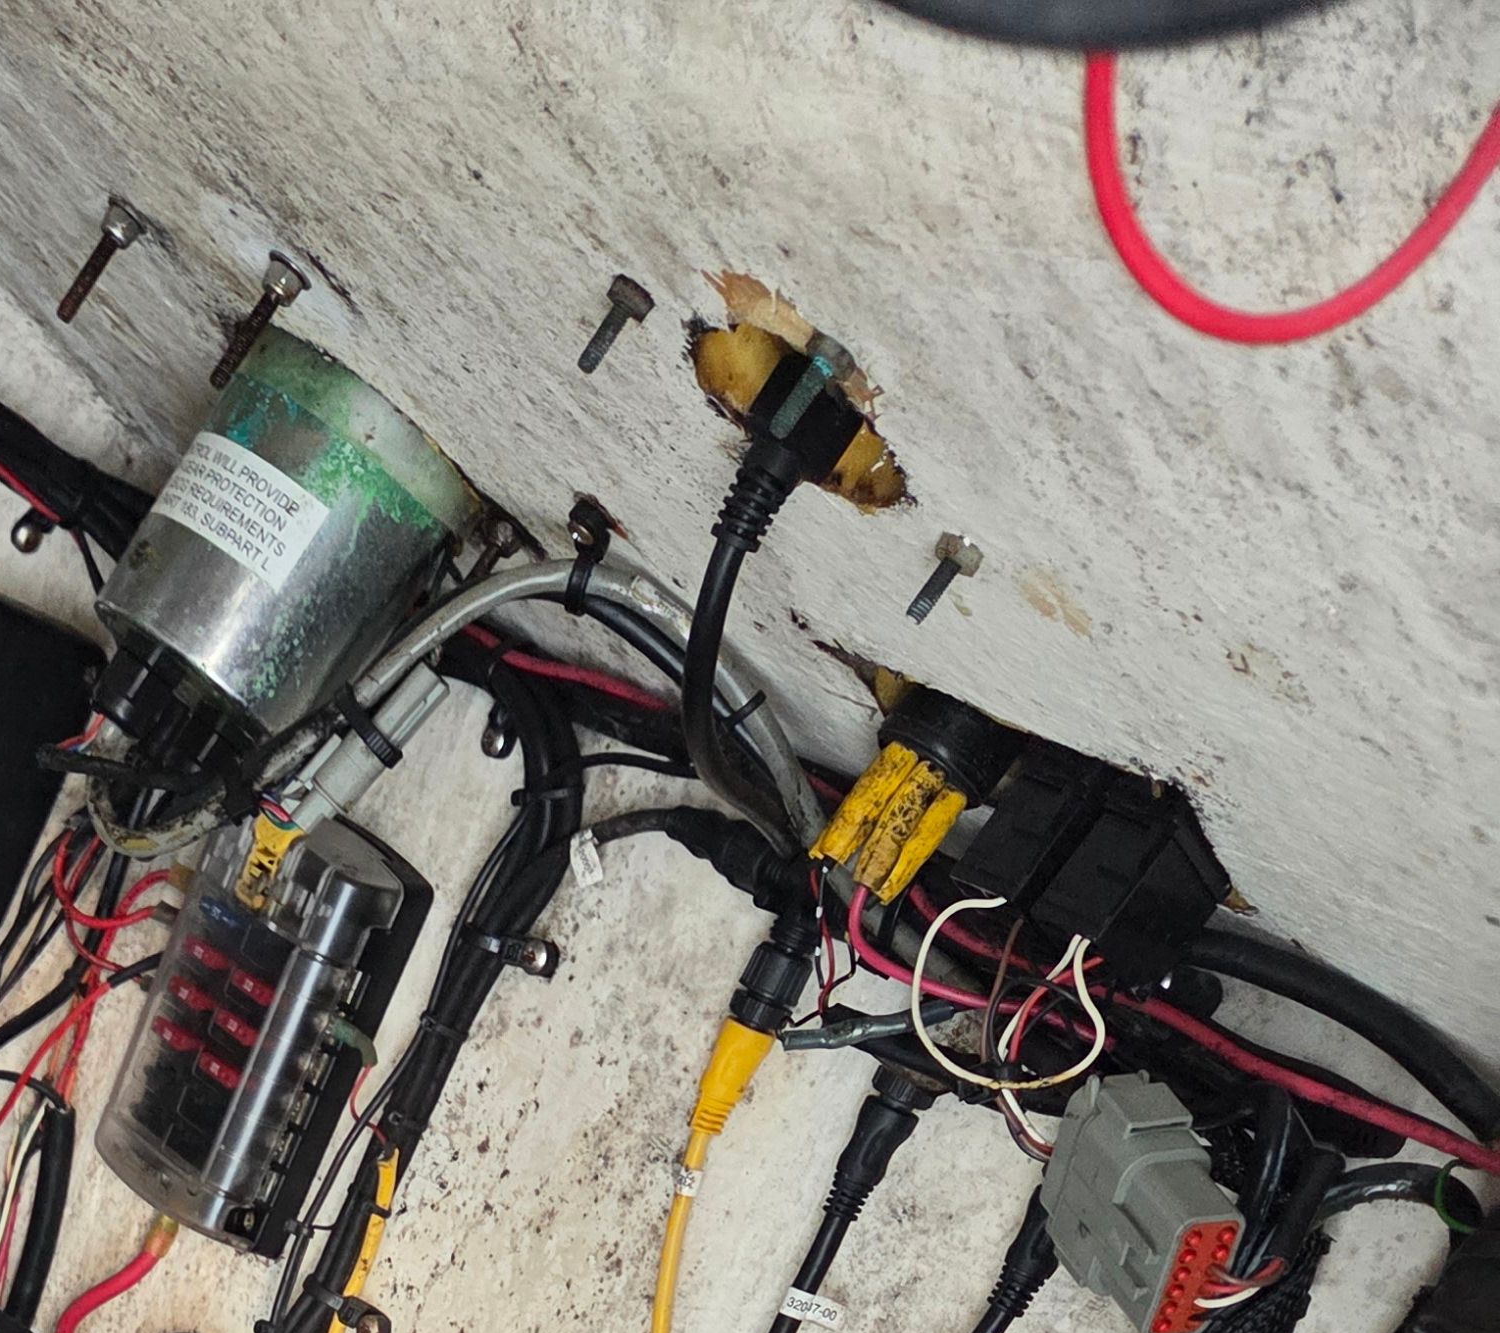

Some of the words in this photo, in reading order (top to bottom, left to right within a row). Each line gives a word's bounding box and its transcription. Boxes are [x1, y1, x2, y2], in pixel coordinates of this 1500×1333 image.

[213, 450, 239, 477] WILL
[190, 482, 286, 556] REQUIREMENTS
[204, 469, 287, 531] PROTECTION
[200, 512, 262, 561] SUBPART
[261, 556, 268, 572] L
